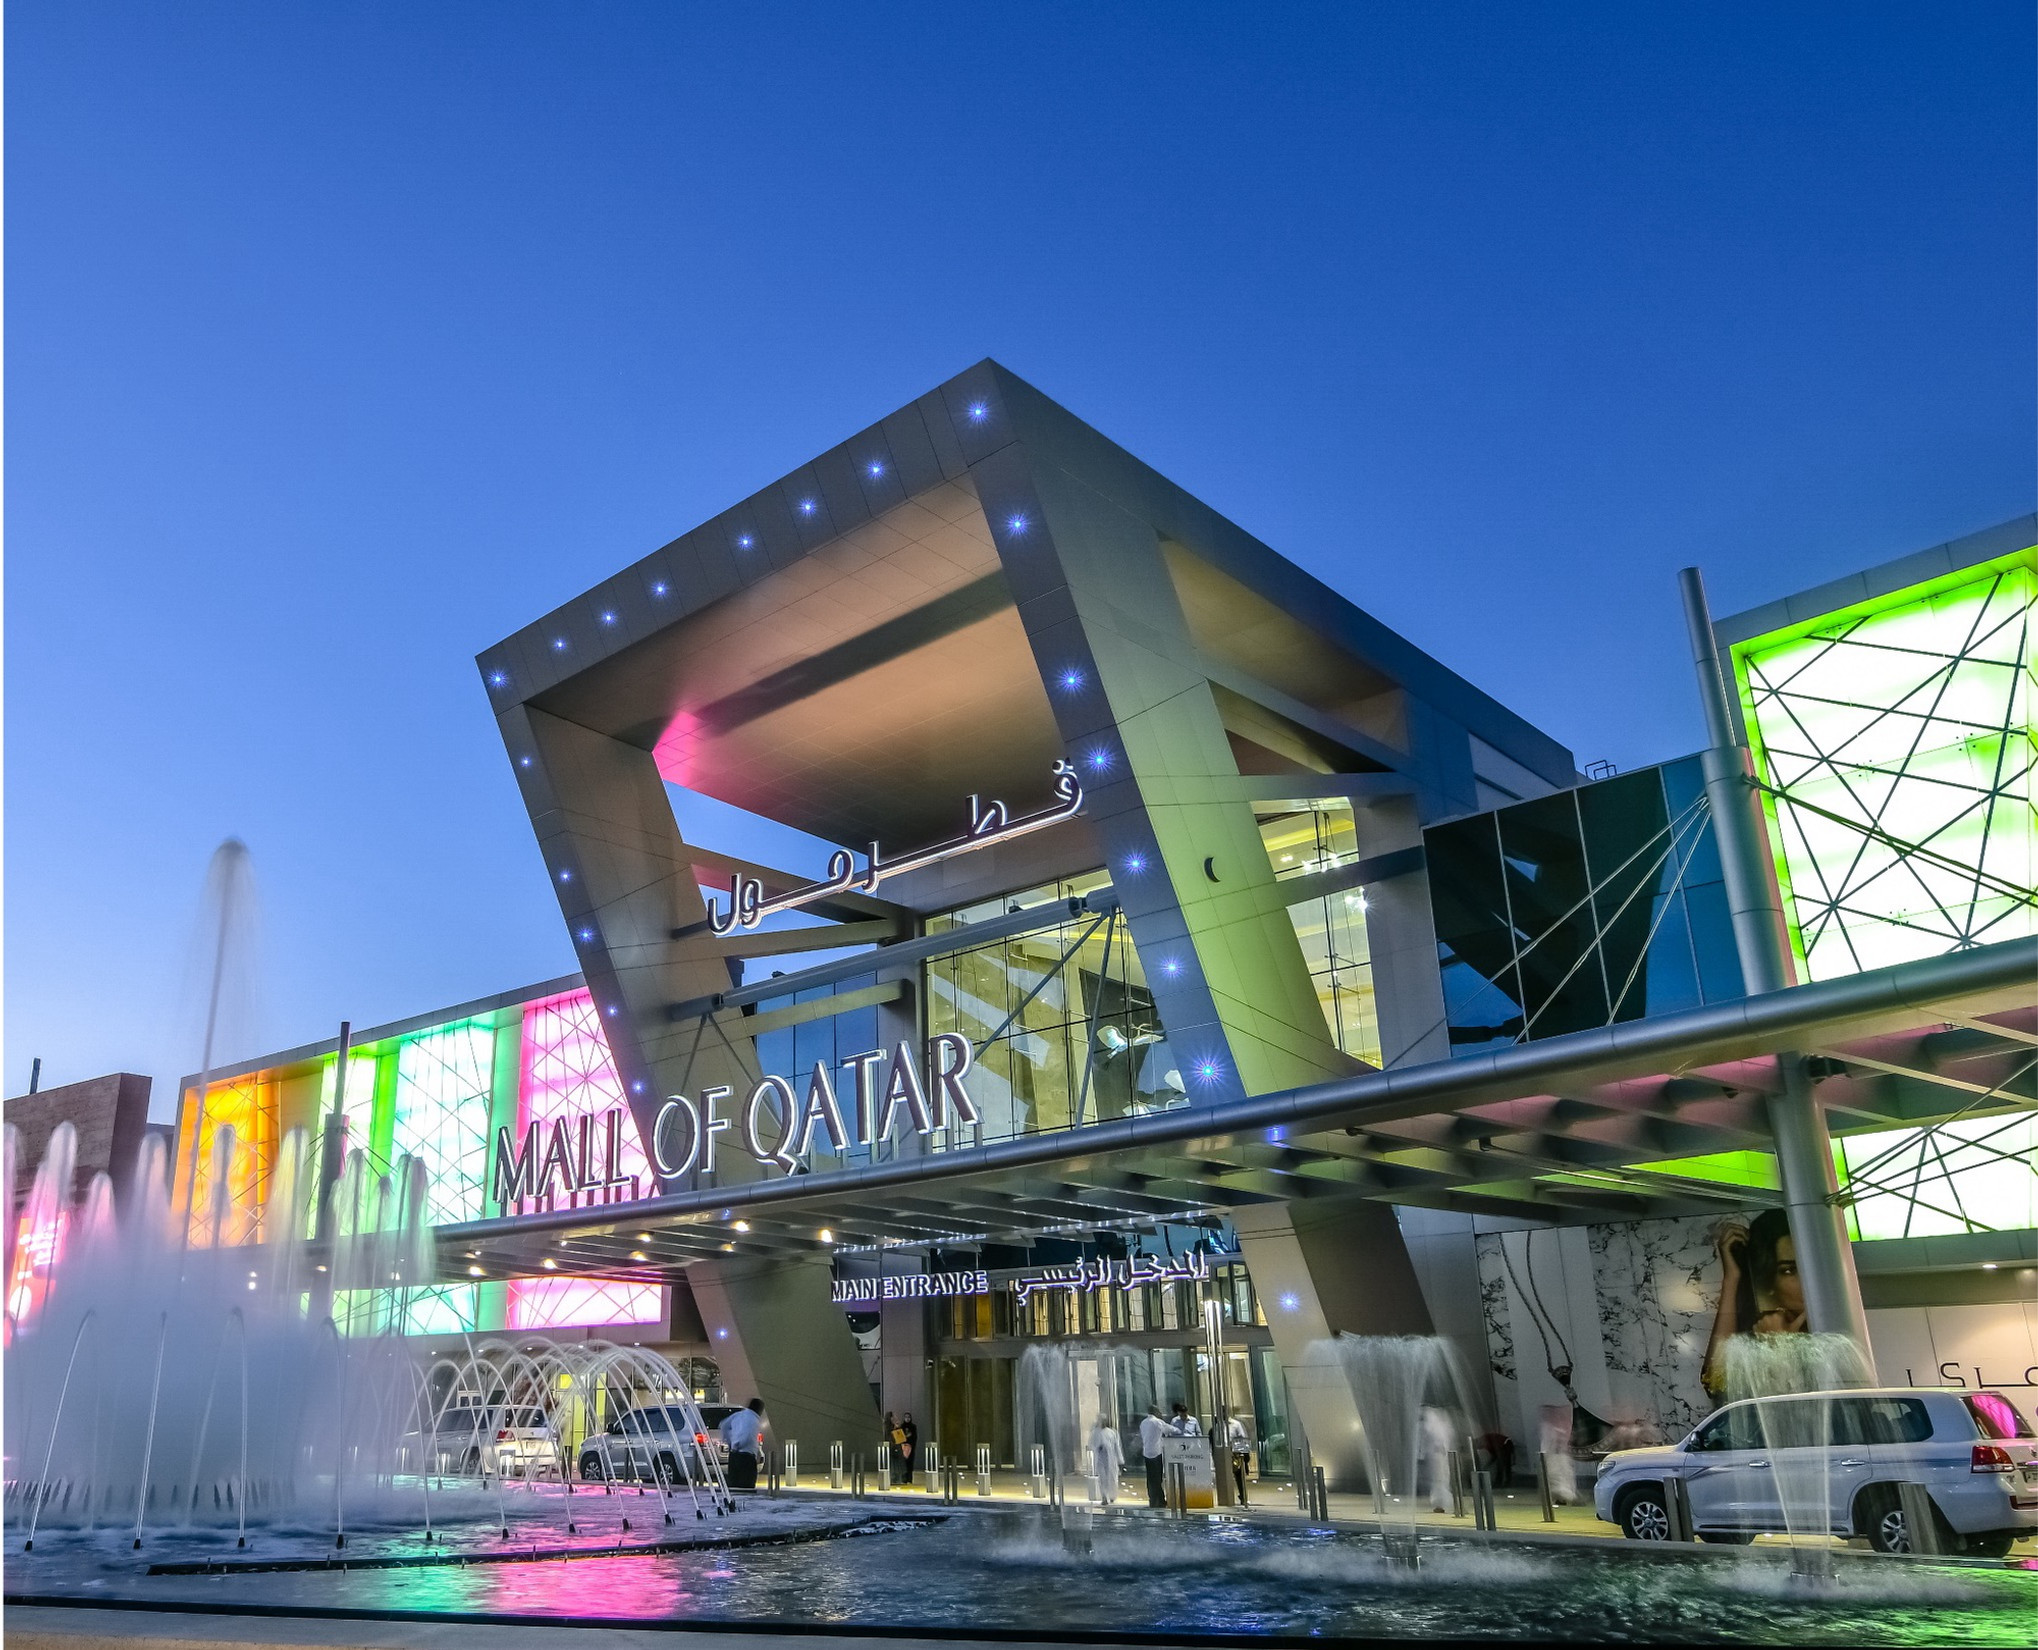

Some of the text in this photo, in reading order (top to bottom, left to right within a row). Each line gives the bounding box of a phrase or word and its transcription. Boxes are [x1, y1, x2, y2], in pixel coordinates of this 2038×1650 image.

[707, 756, 1083, 937] قطر مول
[492, 1032, 985, 1204] MALL OF QATAR
[831, 1270, 990, 1302] MAIN ENTRANCE
[1015, 1248, 1208, 1306] المدخل الرئيسي
